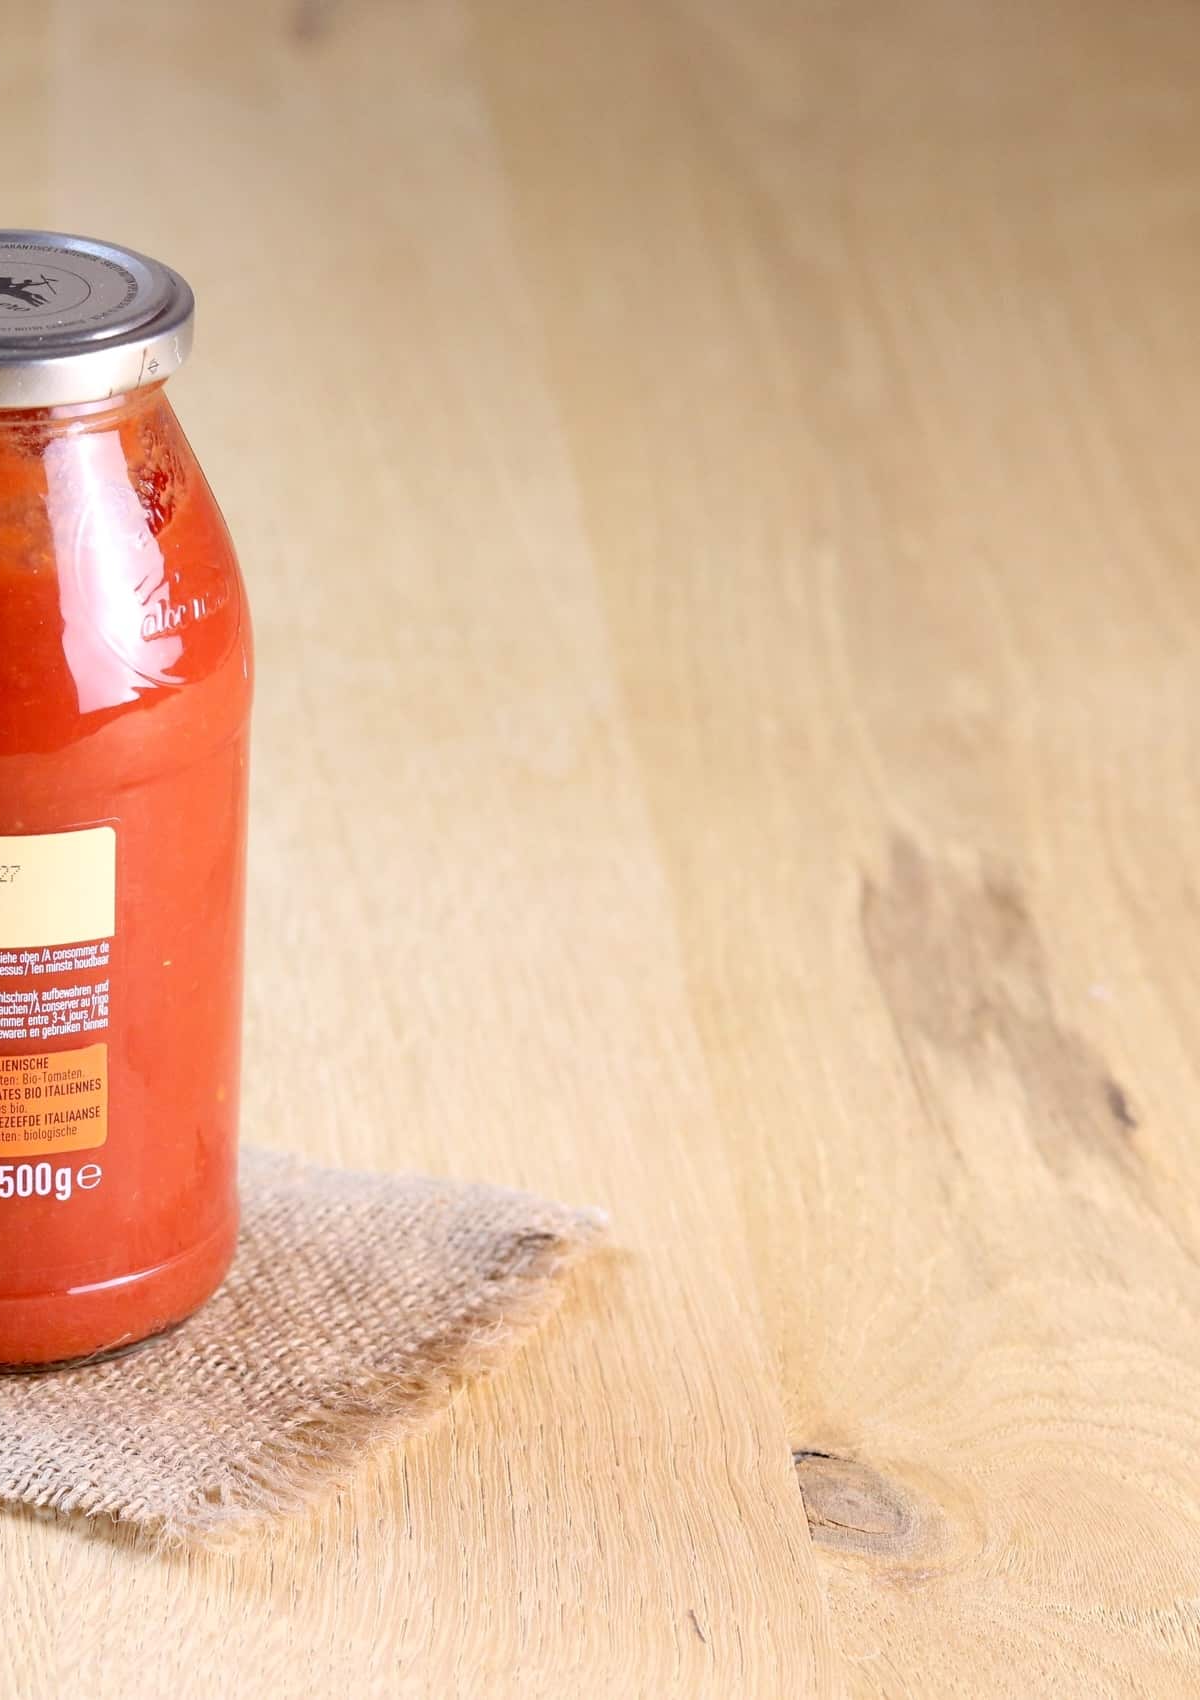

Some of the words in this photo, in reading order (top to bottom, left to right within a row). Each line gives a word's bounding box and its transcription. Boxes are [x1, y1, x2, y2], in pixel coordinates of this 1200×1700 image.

[20, 949, 40, 962] oben
[53, 943, 98, 960] consommer
[100, 941, 110, 954] de
[31, 961, 45, 974] Ten
[46, 957, 73, 973] minste
[74, 952, 109, 968] houdbaar
[42, 984, 91, 1001] aufbewahren
[94, 979, 109, 994] und
[28, 1012, 49, 1026] entre
[52, 1010, 66, 1025] 3-4
[67, 1007, 88, 1025] jours
[98, 1004, 109, 1017] Na
[42, 998, 79, 1013] conserver
[81, 996, 91, 1008] au
[30, 1025, 40, 1038] en
[42, 1022, 81, 1041] gebruiken
[83, 1017, 108, 1032] binnen
[24, 1086, 42, 1100] BIO
[44, 1077, 101, 1098] ITALIENNES
[10, 1101, 27, 1115] bio.
[44, 1105, 101, 1126] ITALIAANSE
